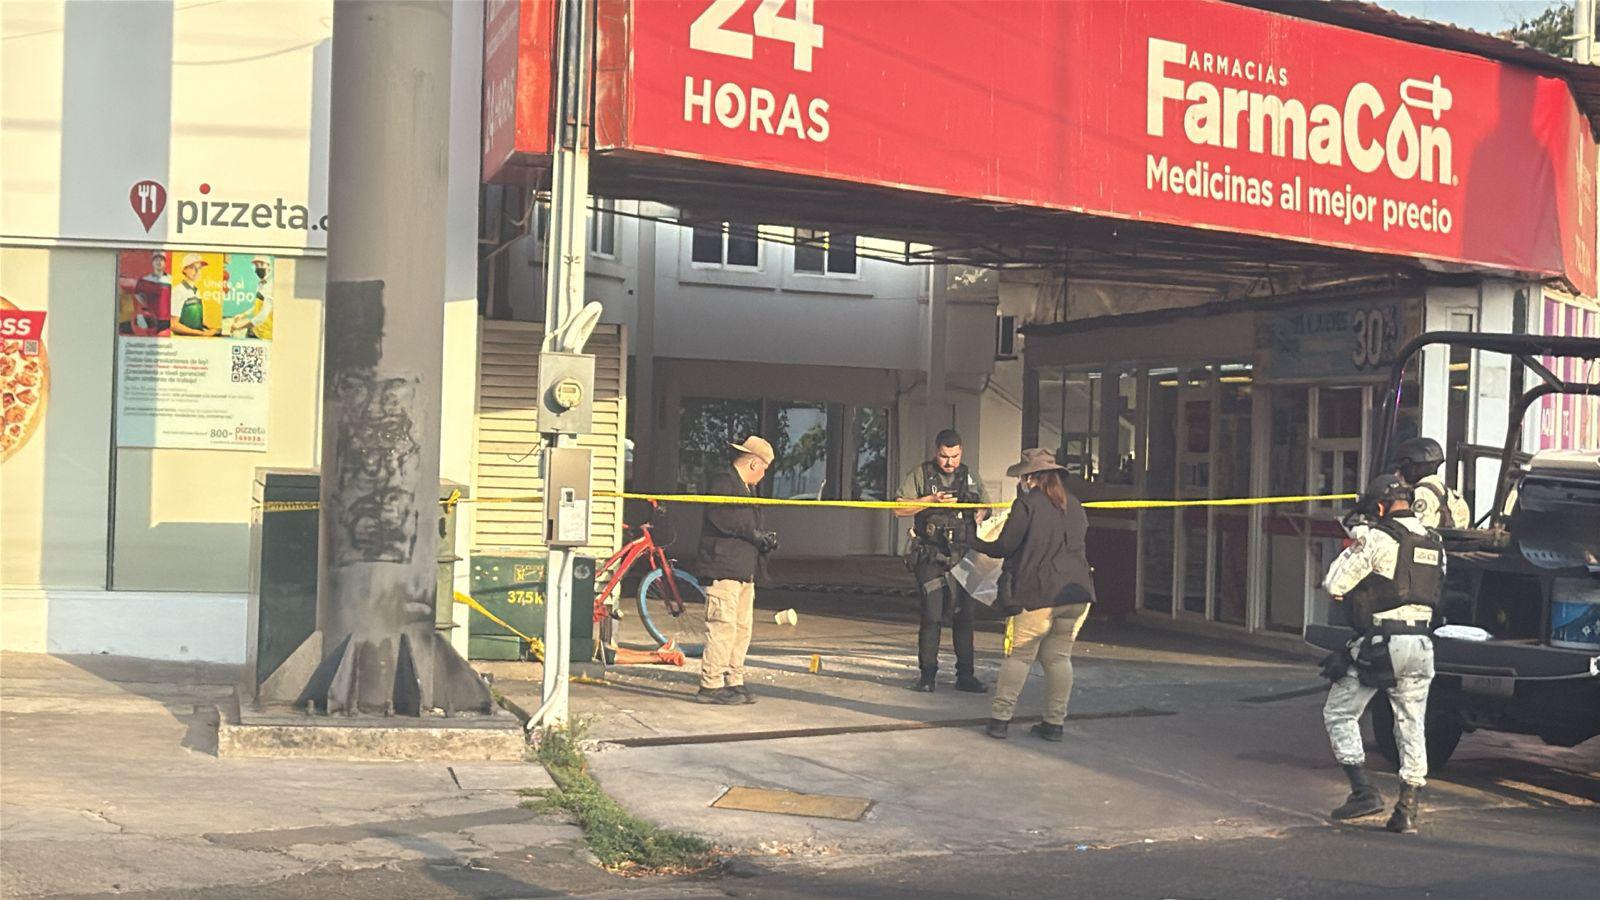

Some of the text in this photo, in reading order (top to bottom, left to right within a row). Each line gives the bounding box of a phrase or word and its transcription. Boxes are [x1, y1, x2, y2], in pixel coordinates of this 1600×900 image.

[690, 0, 823, 72] 24
[684, 76, 830, 142] HORAS
[1146, 154, 1453, 235] Medicinas al mejor precio
[0, 317, 32, 336] SS
